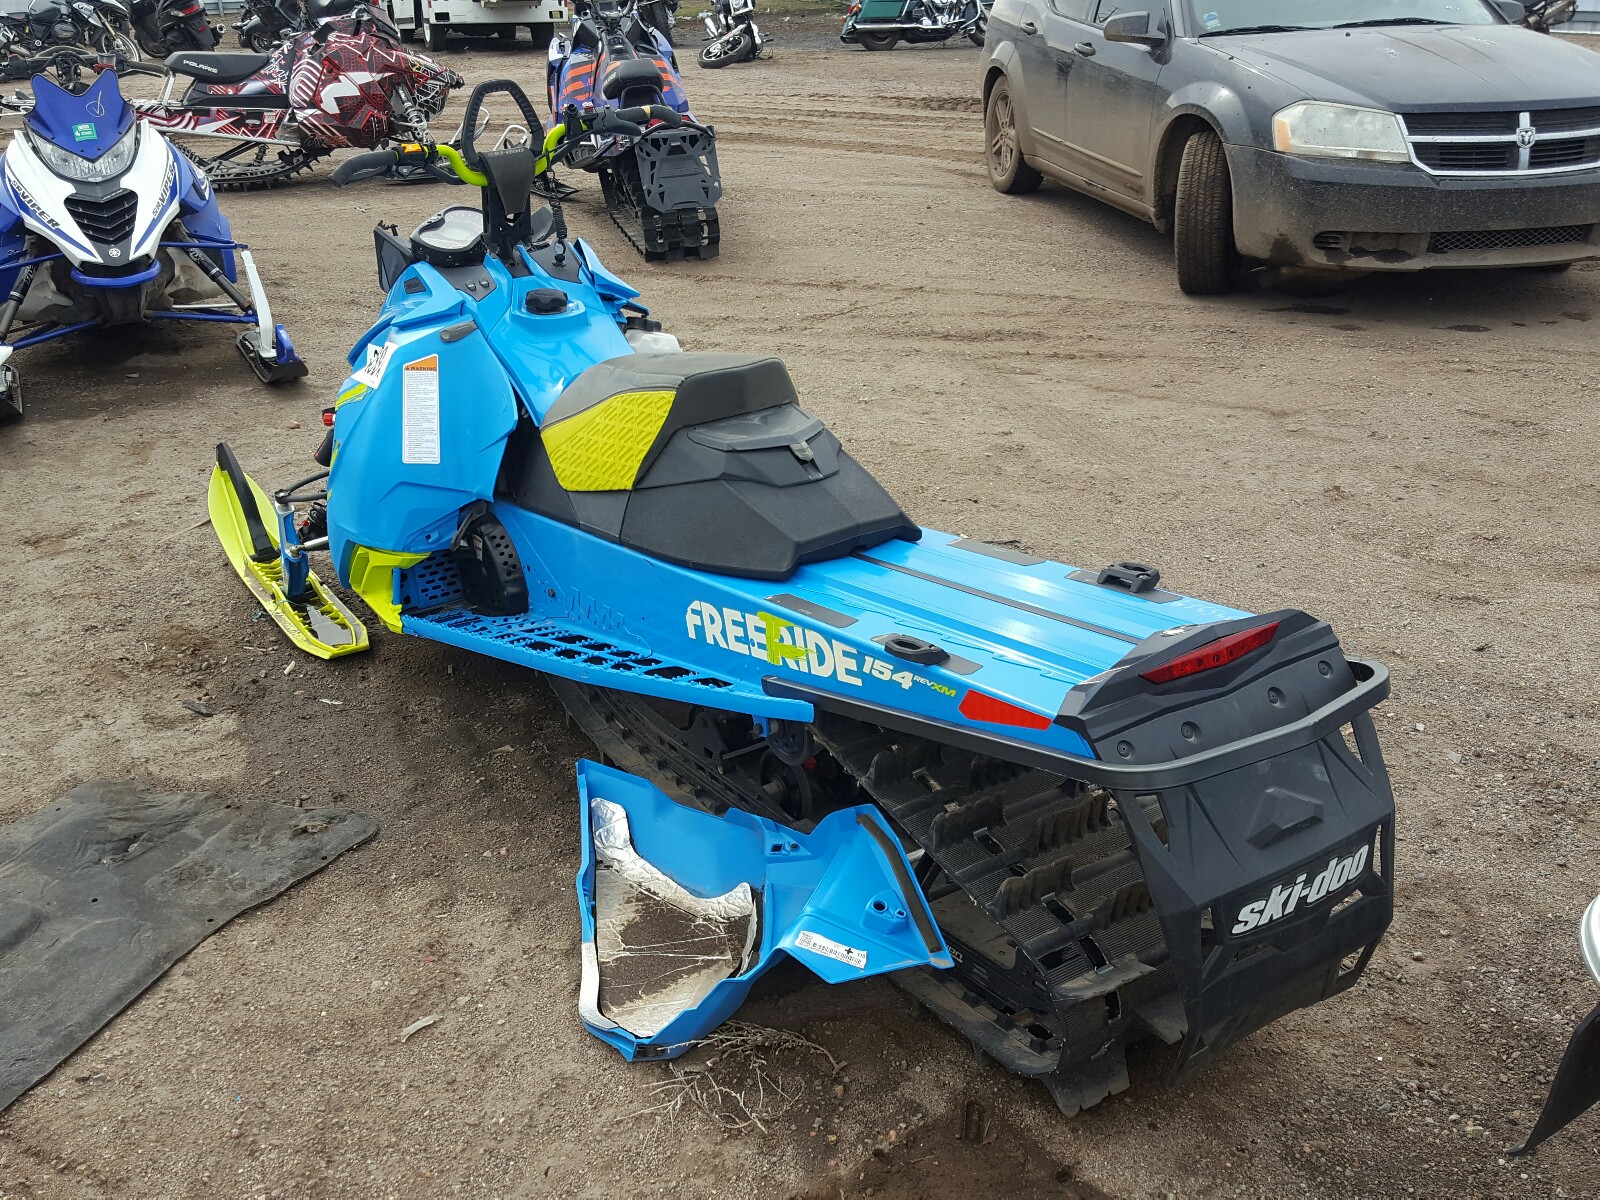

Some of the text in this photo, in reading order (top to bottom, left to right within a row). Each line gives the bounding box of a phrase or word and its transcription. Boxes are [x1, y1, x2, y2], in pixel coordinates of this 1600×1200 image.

[183, 59, 218, 74] POLARIS
[863, 656, 913, 690] 154
[1231, 844, 1369, 935] ski-doo
